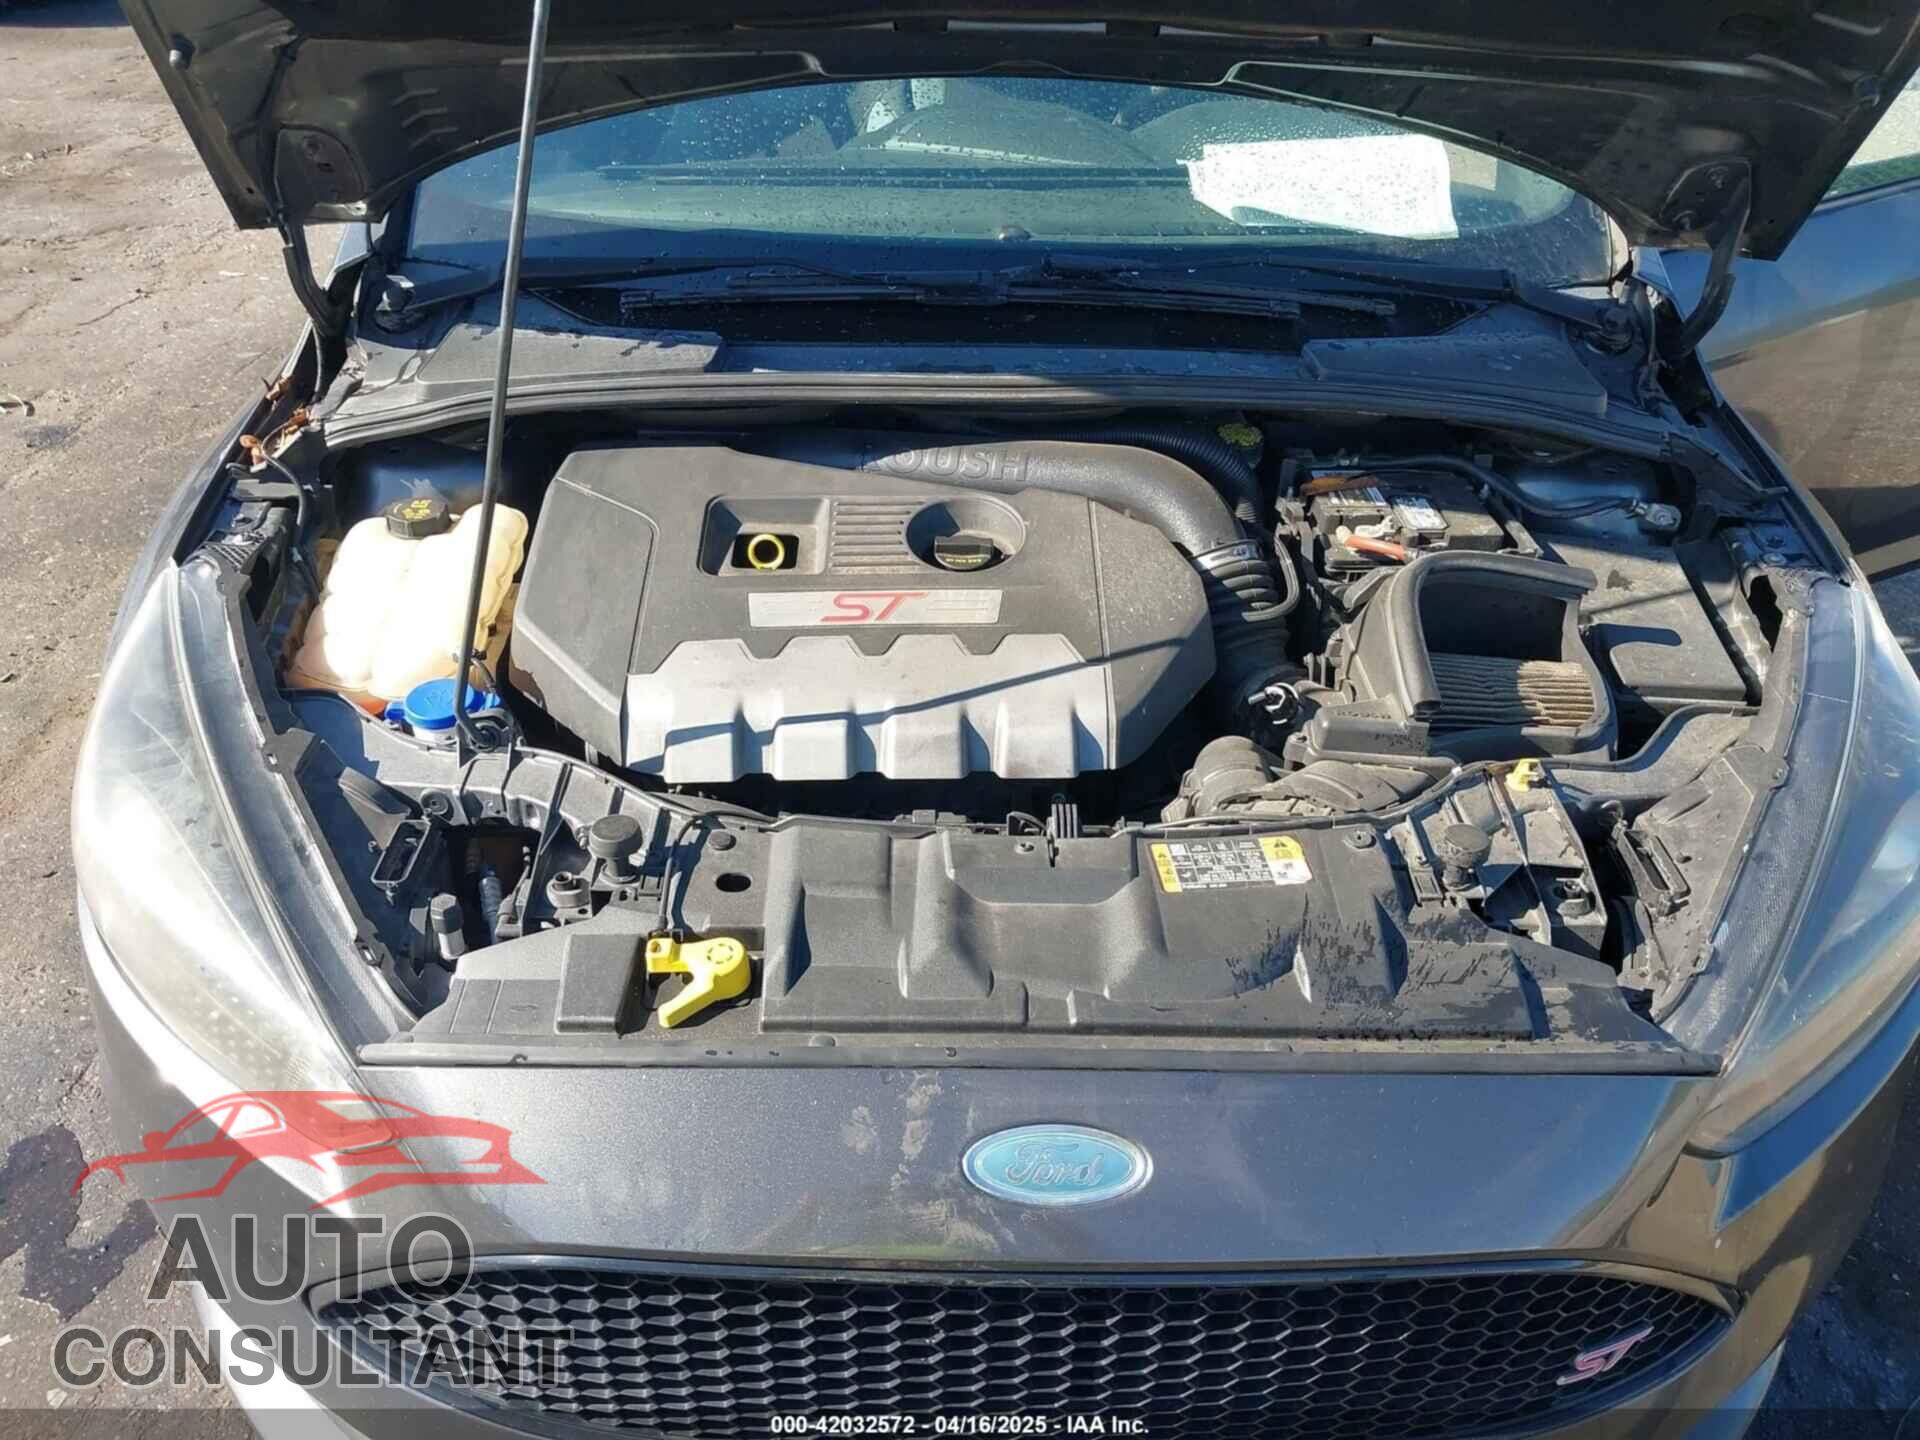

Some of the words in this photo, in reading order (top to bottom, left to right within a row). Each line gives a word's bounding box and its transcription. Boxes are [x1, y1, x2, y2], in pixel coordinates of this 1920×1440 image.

[862, 448, 1029, 481] OUSH
[821, 591, 928, 622] ST
[1005, 1141, 1104, 1186] Ford
[1556, 1326, 1654, 1386] ST
